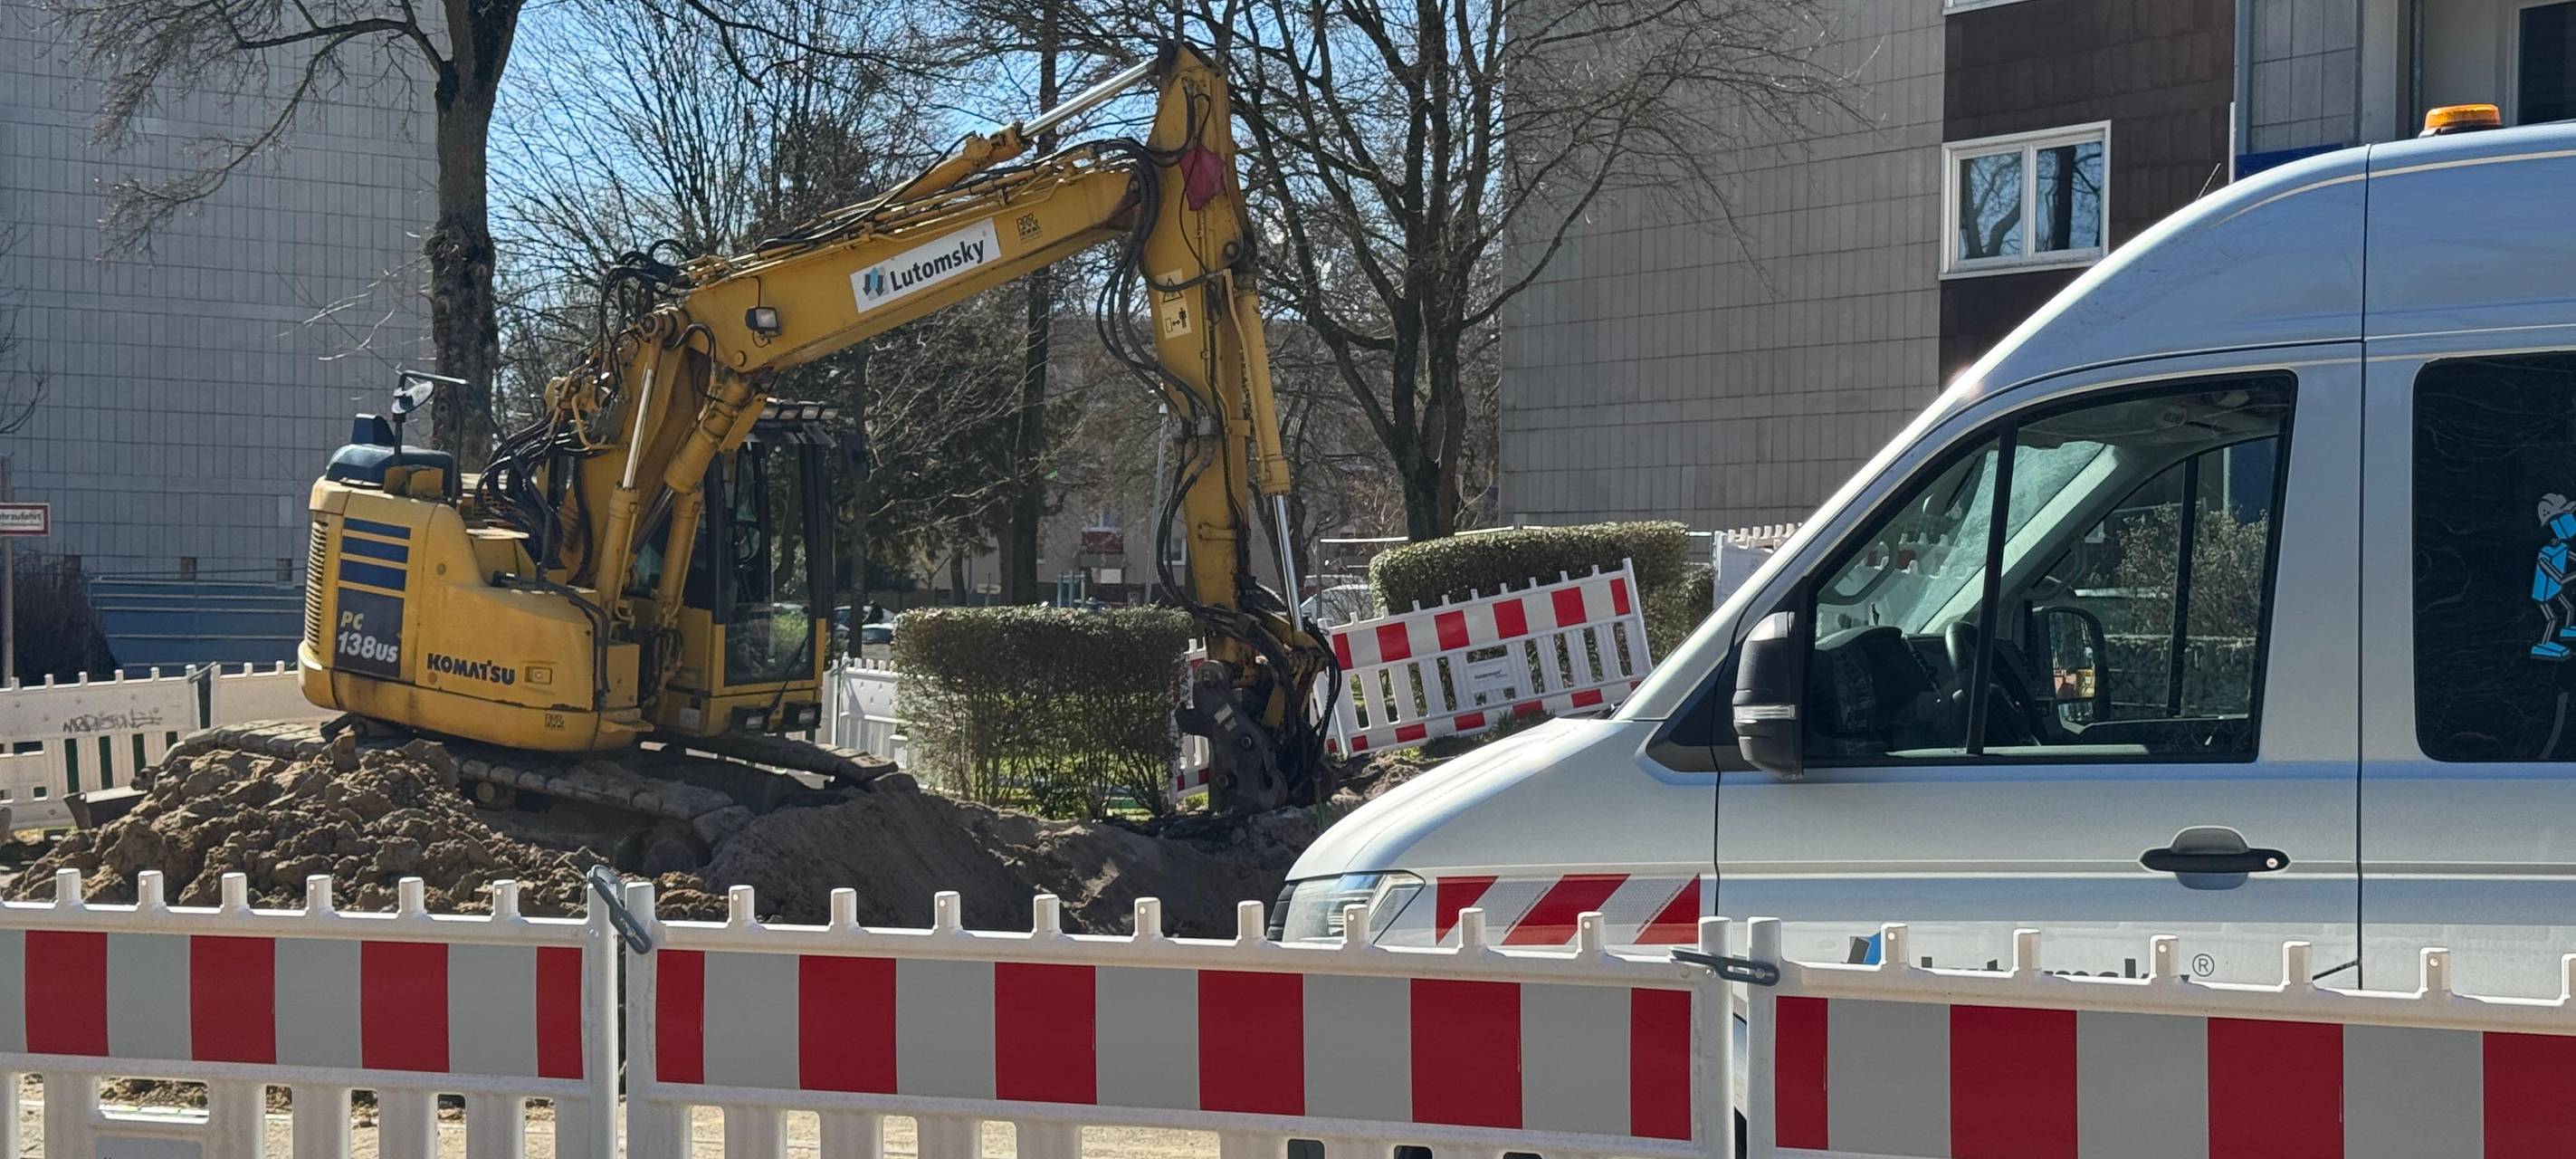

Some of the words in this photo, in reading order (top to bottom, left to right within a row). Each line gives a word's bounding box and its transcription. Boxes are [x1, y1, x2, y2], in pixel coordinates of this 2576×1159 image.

[890, 239, 985, 292] Lutomsky
[340, 610, 365, 631] PC
[427, 653, 515, 685] KOMATSU
